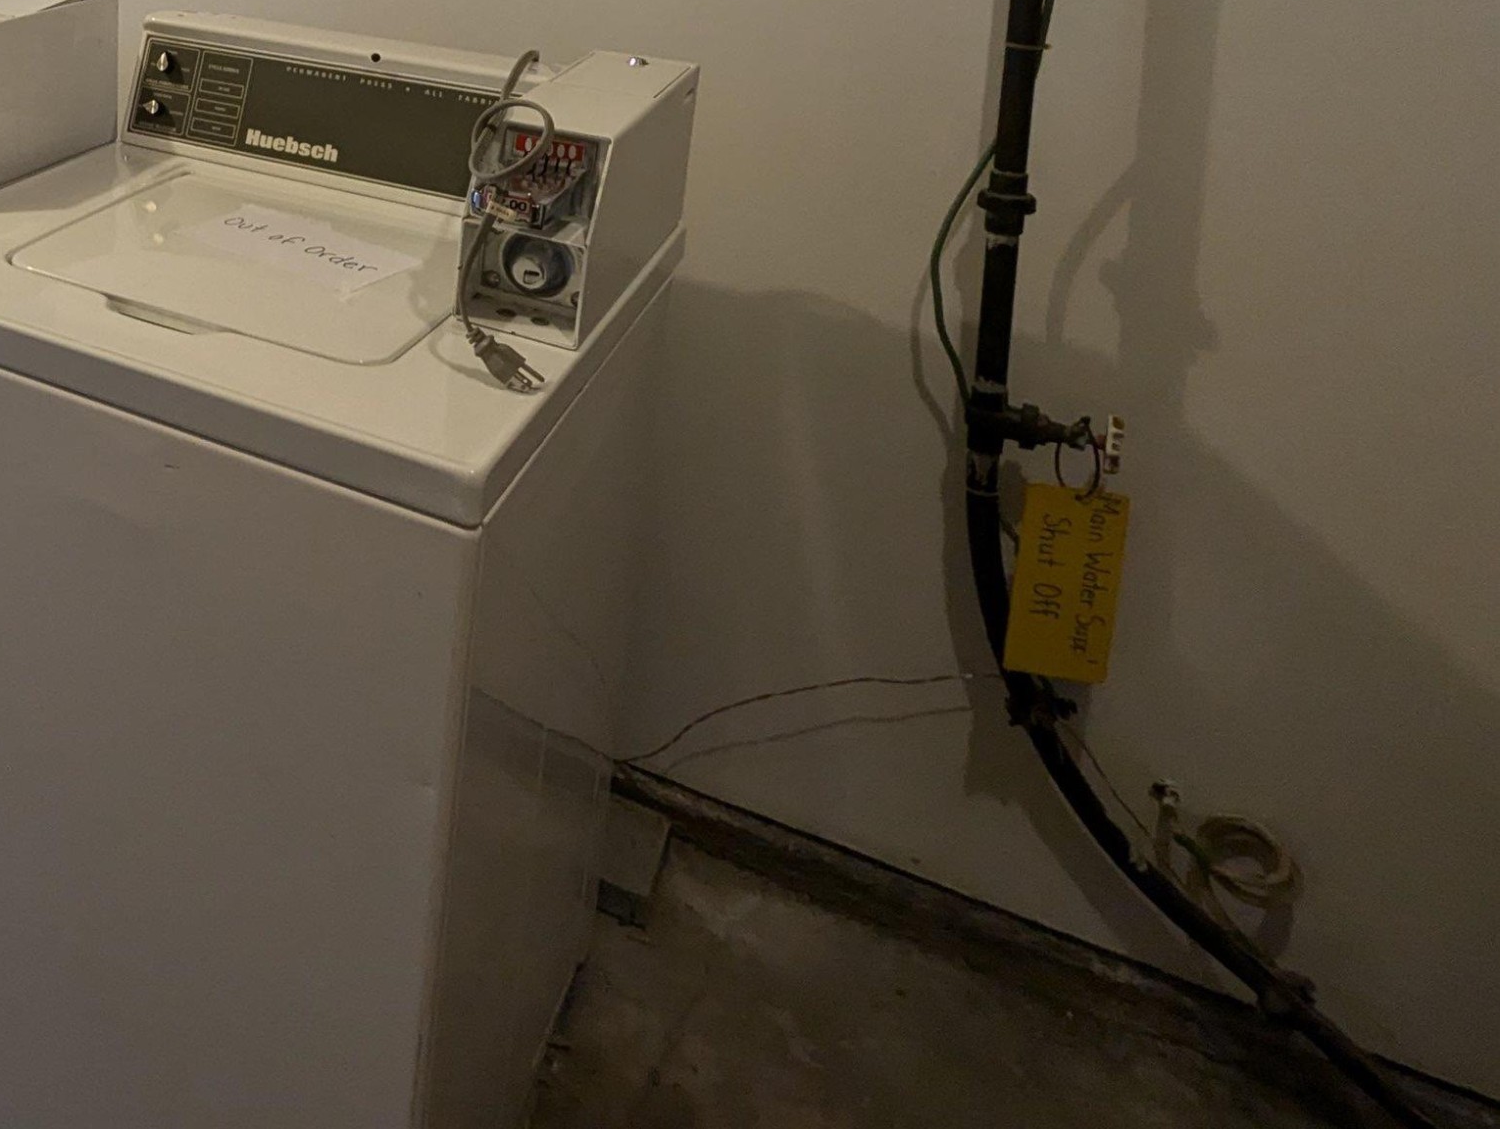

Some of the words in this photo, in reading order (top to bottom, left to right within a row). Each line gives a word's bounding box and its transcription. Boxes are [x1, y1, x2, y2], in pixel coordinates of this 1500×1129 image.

[245, 128, 339, 162] Huebsch
[224, 217, 269, 233] Out
[304, 246, 378, 272] Order
[1036, 513, 1072, 568] Shut
[1088, 492, 1122, 546] Main
[1029, 582, 1063, 620] Off
[1078, 552, 1114, 610] Water
